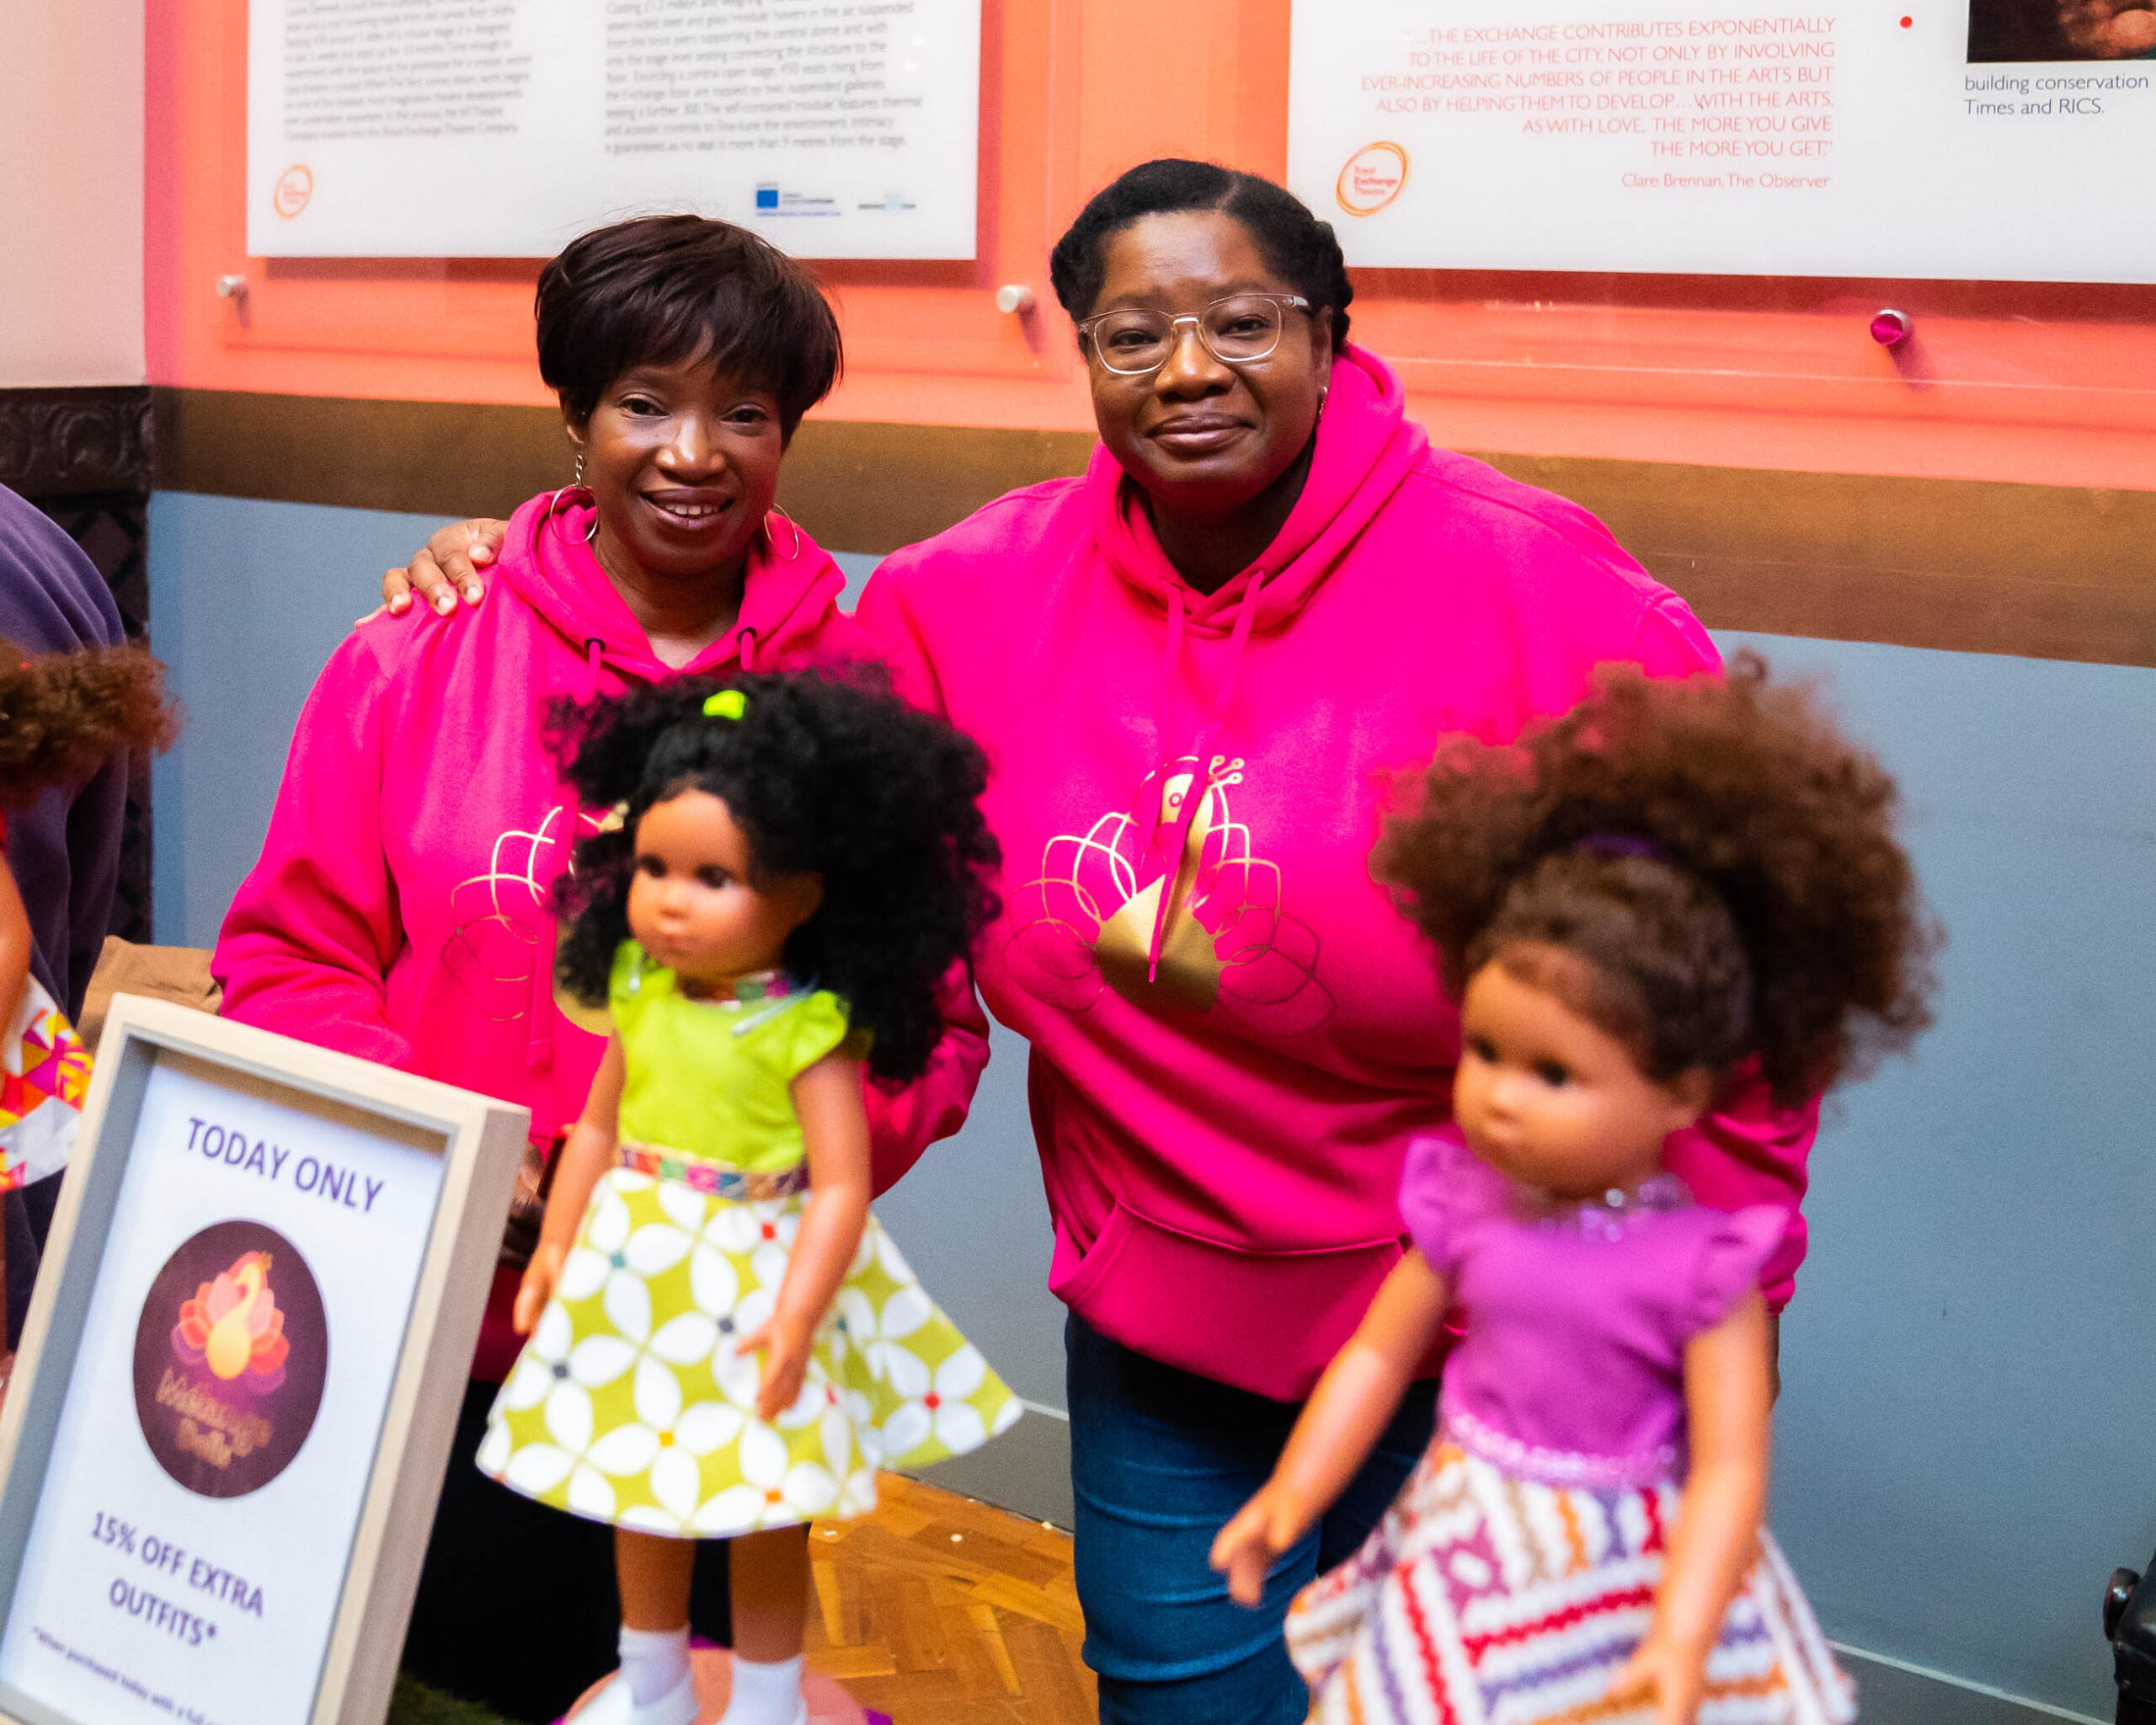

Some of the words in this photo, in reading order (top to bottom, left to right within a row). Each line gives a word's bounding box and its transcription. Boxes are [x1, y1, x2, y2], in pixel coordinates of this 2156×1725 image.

[1464, 24, 1557, 43] EXCHANGE
[1562, 19, 1684, 40] CONTRIBUTES
[1689, 16, 1837, 36] EXPONENTIALLY
[1408, 51, 1431, 67] TO
[1434, 51, 1465, 67] THE
[1468, 49, 1497, 67] LIFE
[1502, 48, 1524, 65] OF
[1527, 47, 1560, 65] THE
[1608, 45, 1646, 62] NOT
[1652, 44, 1701, 61] ONLY
[1706, 43, 1729, 61] BY
[1733, 40, 1836, 59] INVOLVING
[1505, 70, 1585, 88] NUMBERS
[1589, 69, 1614, 87] OF
[1618, 68, 1680, 86] PEOPLE
[1686, 67, 1705, 84] IN
[1710, 67, 1744, 84] THE
[1746, 66, 1792, 83] ARTS
[1797, 65, 1834, 83] BUT
[1964, 73, 2030, 95] building
[2035, 72, 2149, 91] conservation
[1375, 96, 1417, 113] ALSO
[1422, 96, 1442, 113] BY
[1446, 95, 1515, 112] HELPING
[1519, 94, 1564, 111] THEM
[1568, 93, 1592, 110] TO
[1745, 90, 1782, 108] THE
[1963, 98, 2015, 116] Times
[2020, 97, 2053, 115] and
[2058, 97, 2105, 115] RICS.
[1522, 118, 1544, 134] AS
[1546, 117, 1593, 134] WITH
[1651, 115, 1685, 132] THE
[1691, 115, 1742, 132] MORE
[1746, 115, 1787, 132] YOU
[1791, 115, 1833, 131] GIVE
[1650, 140, 1684, 158] THE
[1689, 140, 1742, 158] MORE
[1743, 140, 1785, 158] YOU
[1621, 173, 1659, 189] Clare
[1727, 171, 1754, 189] The
[1758, 171, 1832, 189] Observer
[187, 1116, 291, 1181] TODAY
[295, 1155, 385, 1213] ONLY
[91, 1510, 138, 1555] 15%
[141, 1534, 186, 1576] OFF
[188, 1556, 264, 1619] EXTRA
